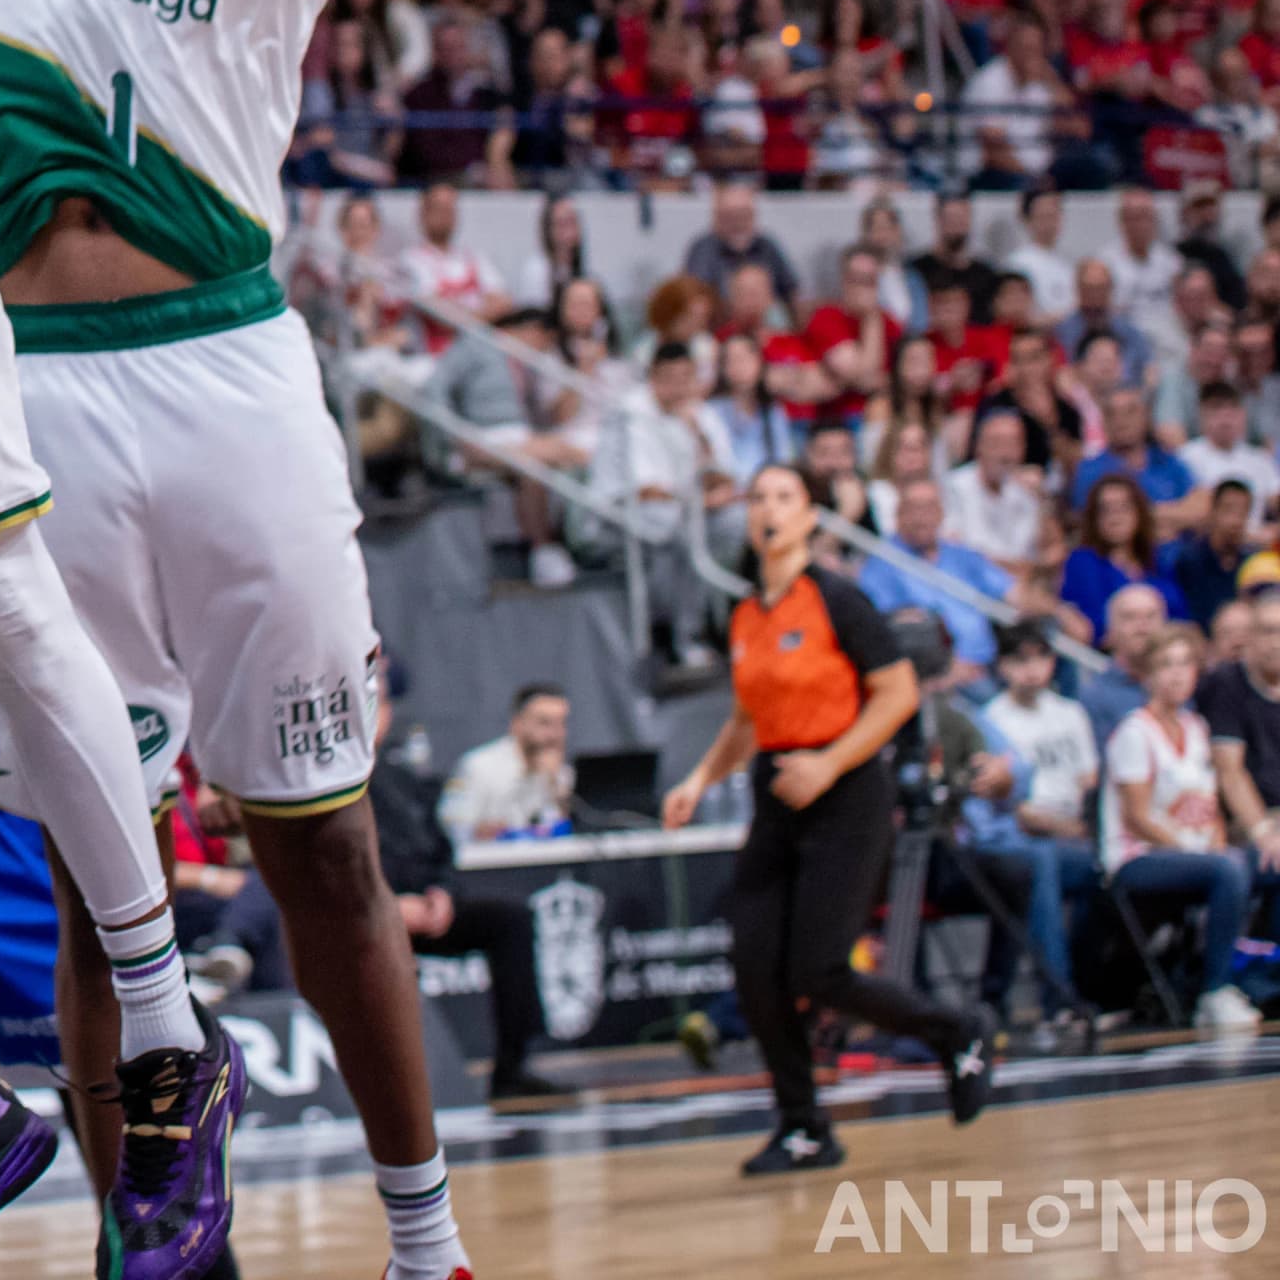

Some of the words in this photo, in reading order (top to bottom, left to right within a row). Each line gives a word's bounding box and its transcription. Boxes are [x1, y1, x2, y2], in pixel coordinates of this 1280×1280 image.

[111, 70, 137, 168] 1
[291, 675, 350, 726] má
[278, 719, 353, 765] laga
